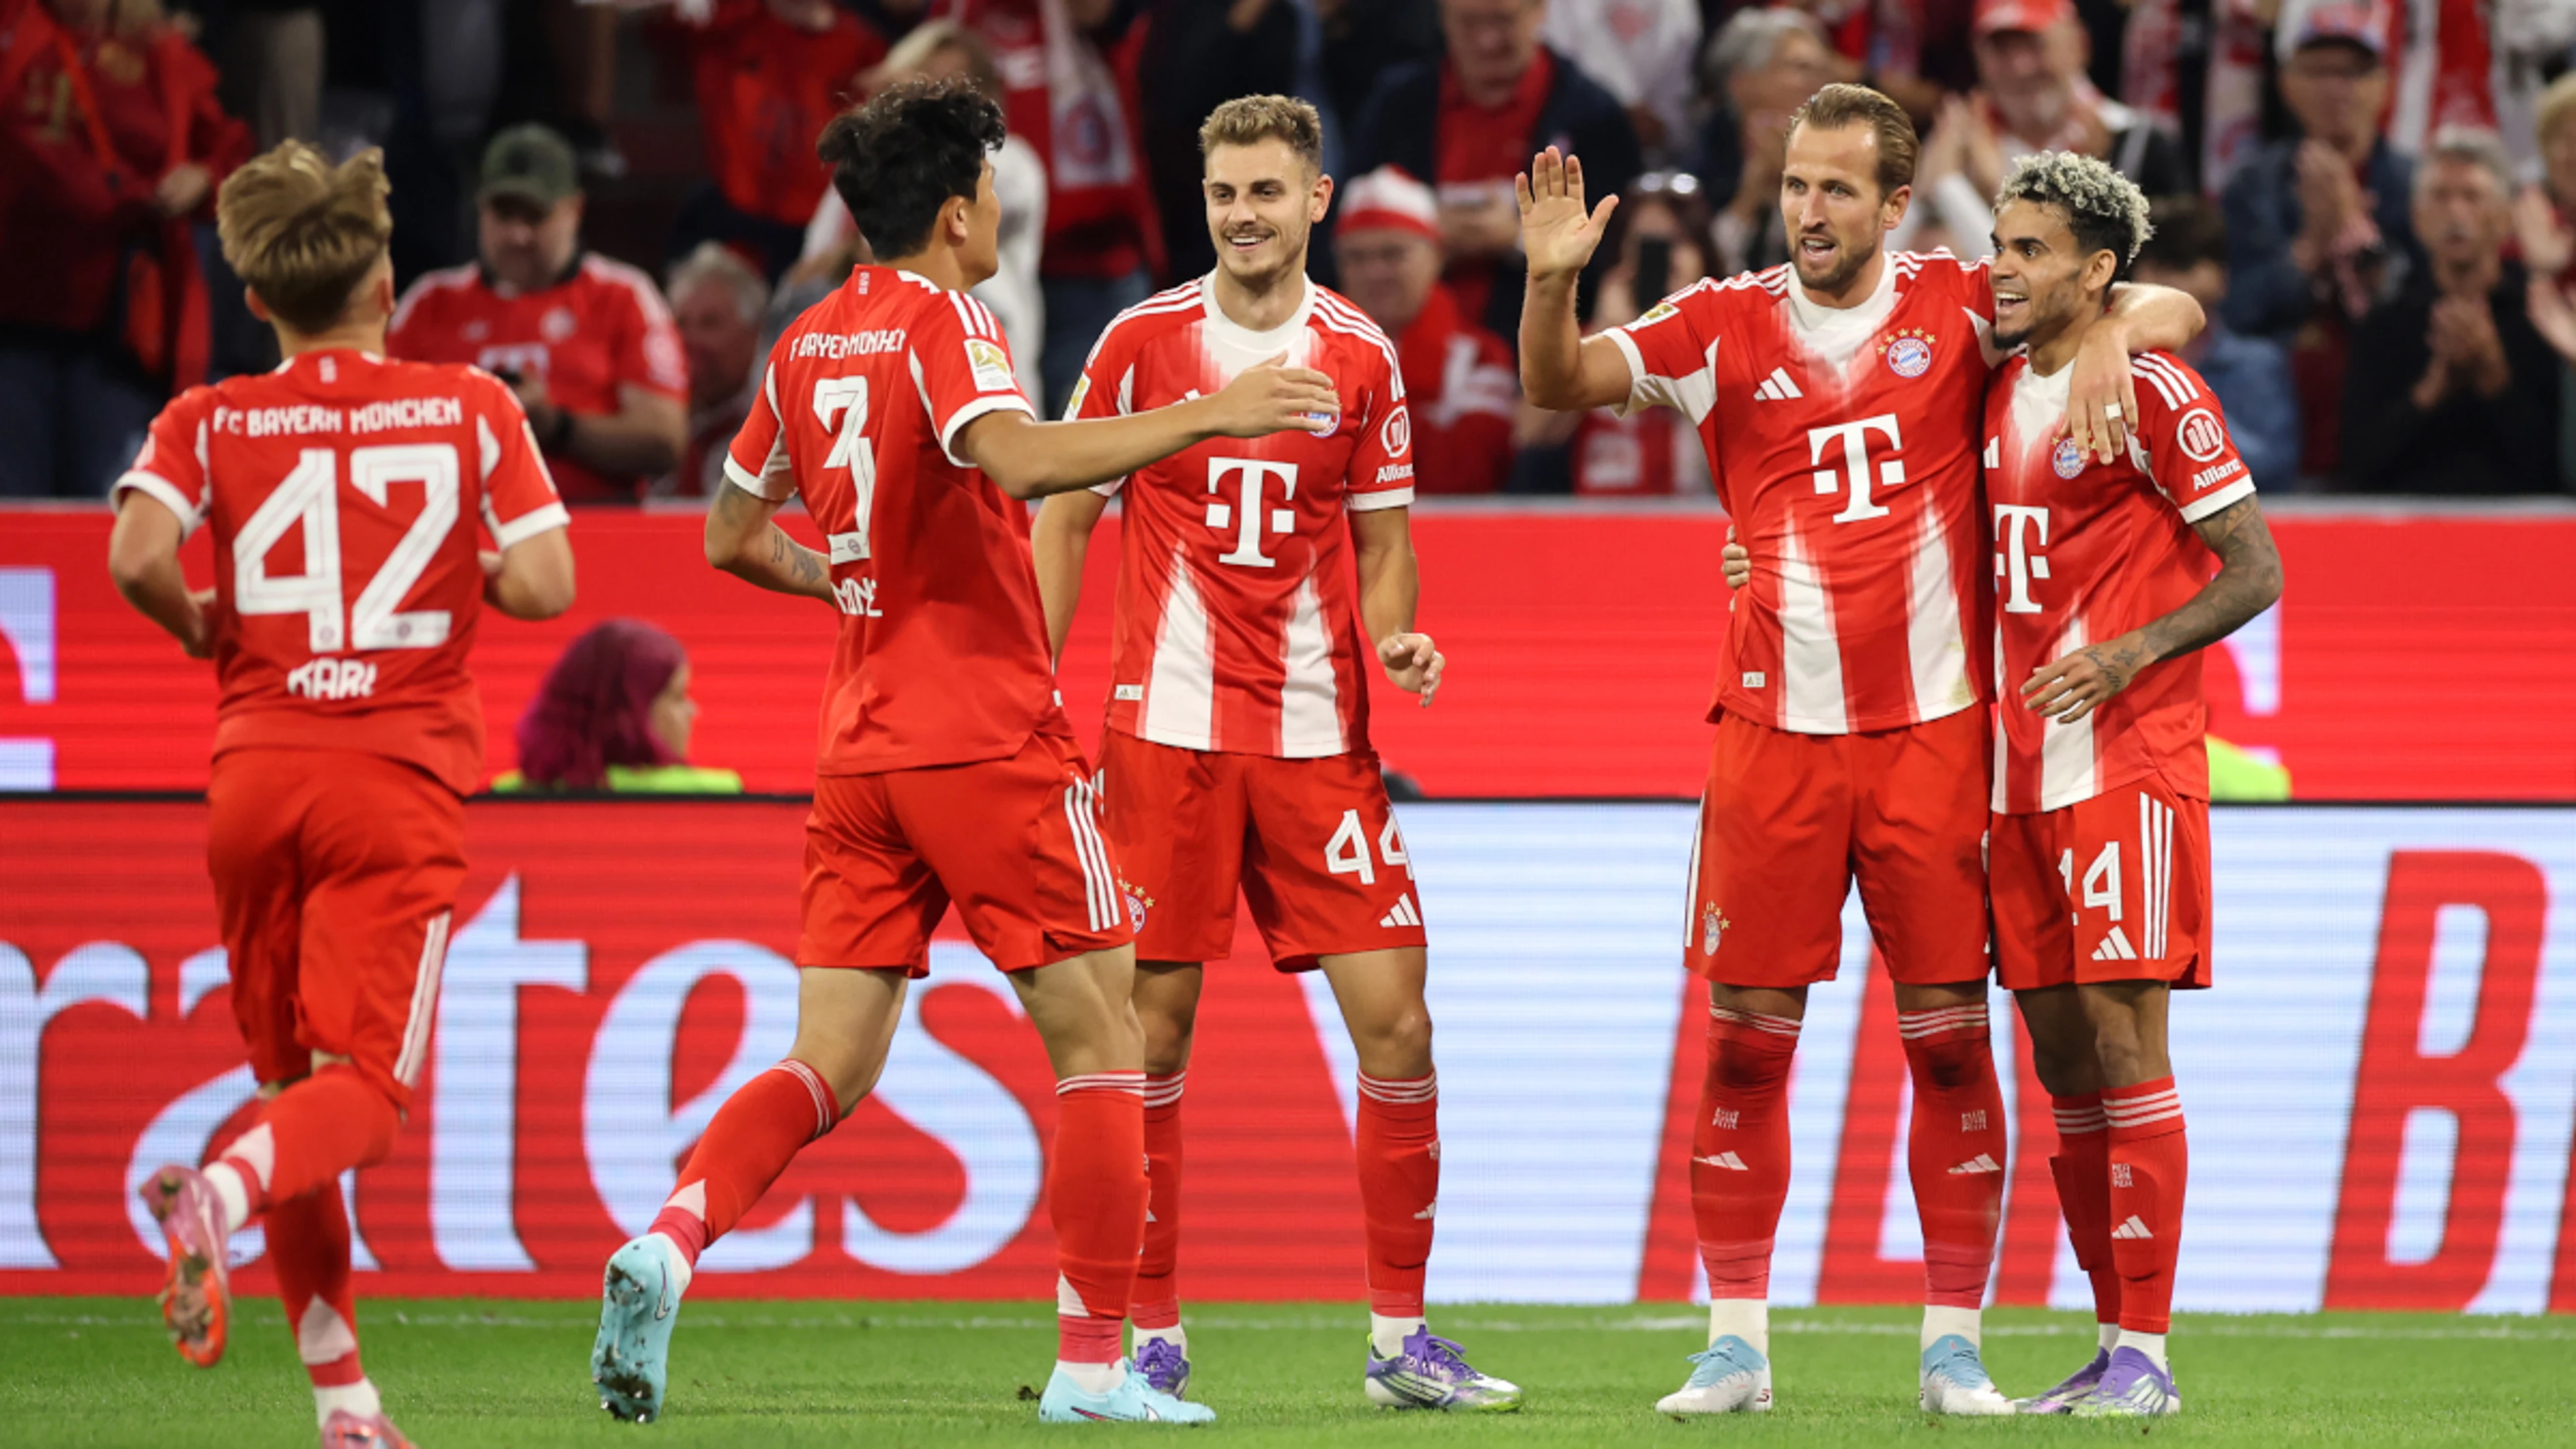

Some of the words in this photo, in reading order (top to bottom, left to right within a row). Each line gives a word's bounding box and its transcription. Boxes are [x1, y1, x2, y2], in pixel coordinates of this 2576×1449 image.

[213, 405, 244, 435] FC
[246, 405, 342, 437] BAYERN
[1808, 413, 1906, 525] T
[2192, 458, 2241, 492] Allianz
[233, 443, 460, 653] 42
[1205, 456, 1299, 568] T
[1994, 504, 2051, 613] T
[287, 656, 377, 700] KARL
[1324, 808, 1414, 884] 44
[2322, 849, 2576, 1313] B
